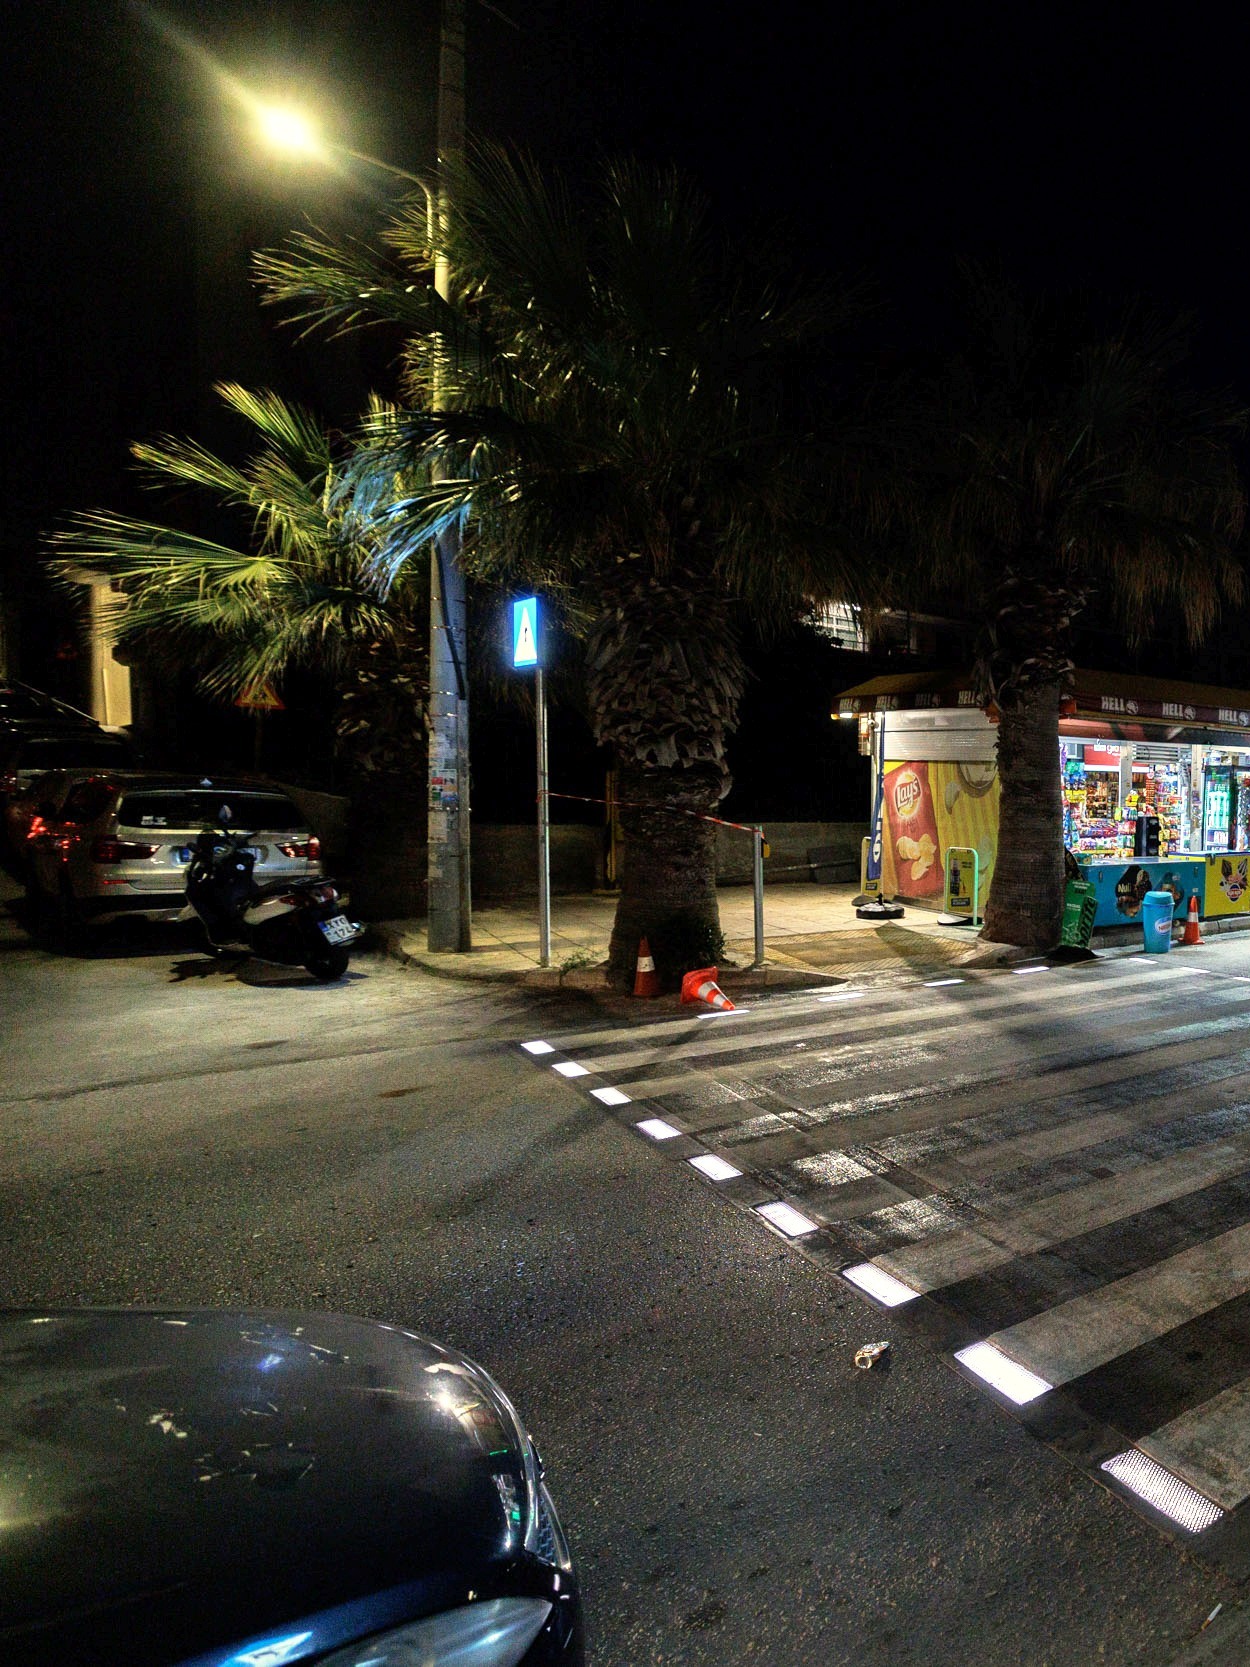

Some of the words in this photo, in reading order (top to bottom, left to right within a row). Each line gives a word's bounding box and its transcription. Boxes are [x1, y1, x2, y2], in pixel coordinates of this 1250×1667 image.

[958, 690, 975, 704] HELL
[1101, 696, 1125, 711] HELL
[1162, 702, 1184, 717] HELL
[1218, 709, 1237, 722] HELL
